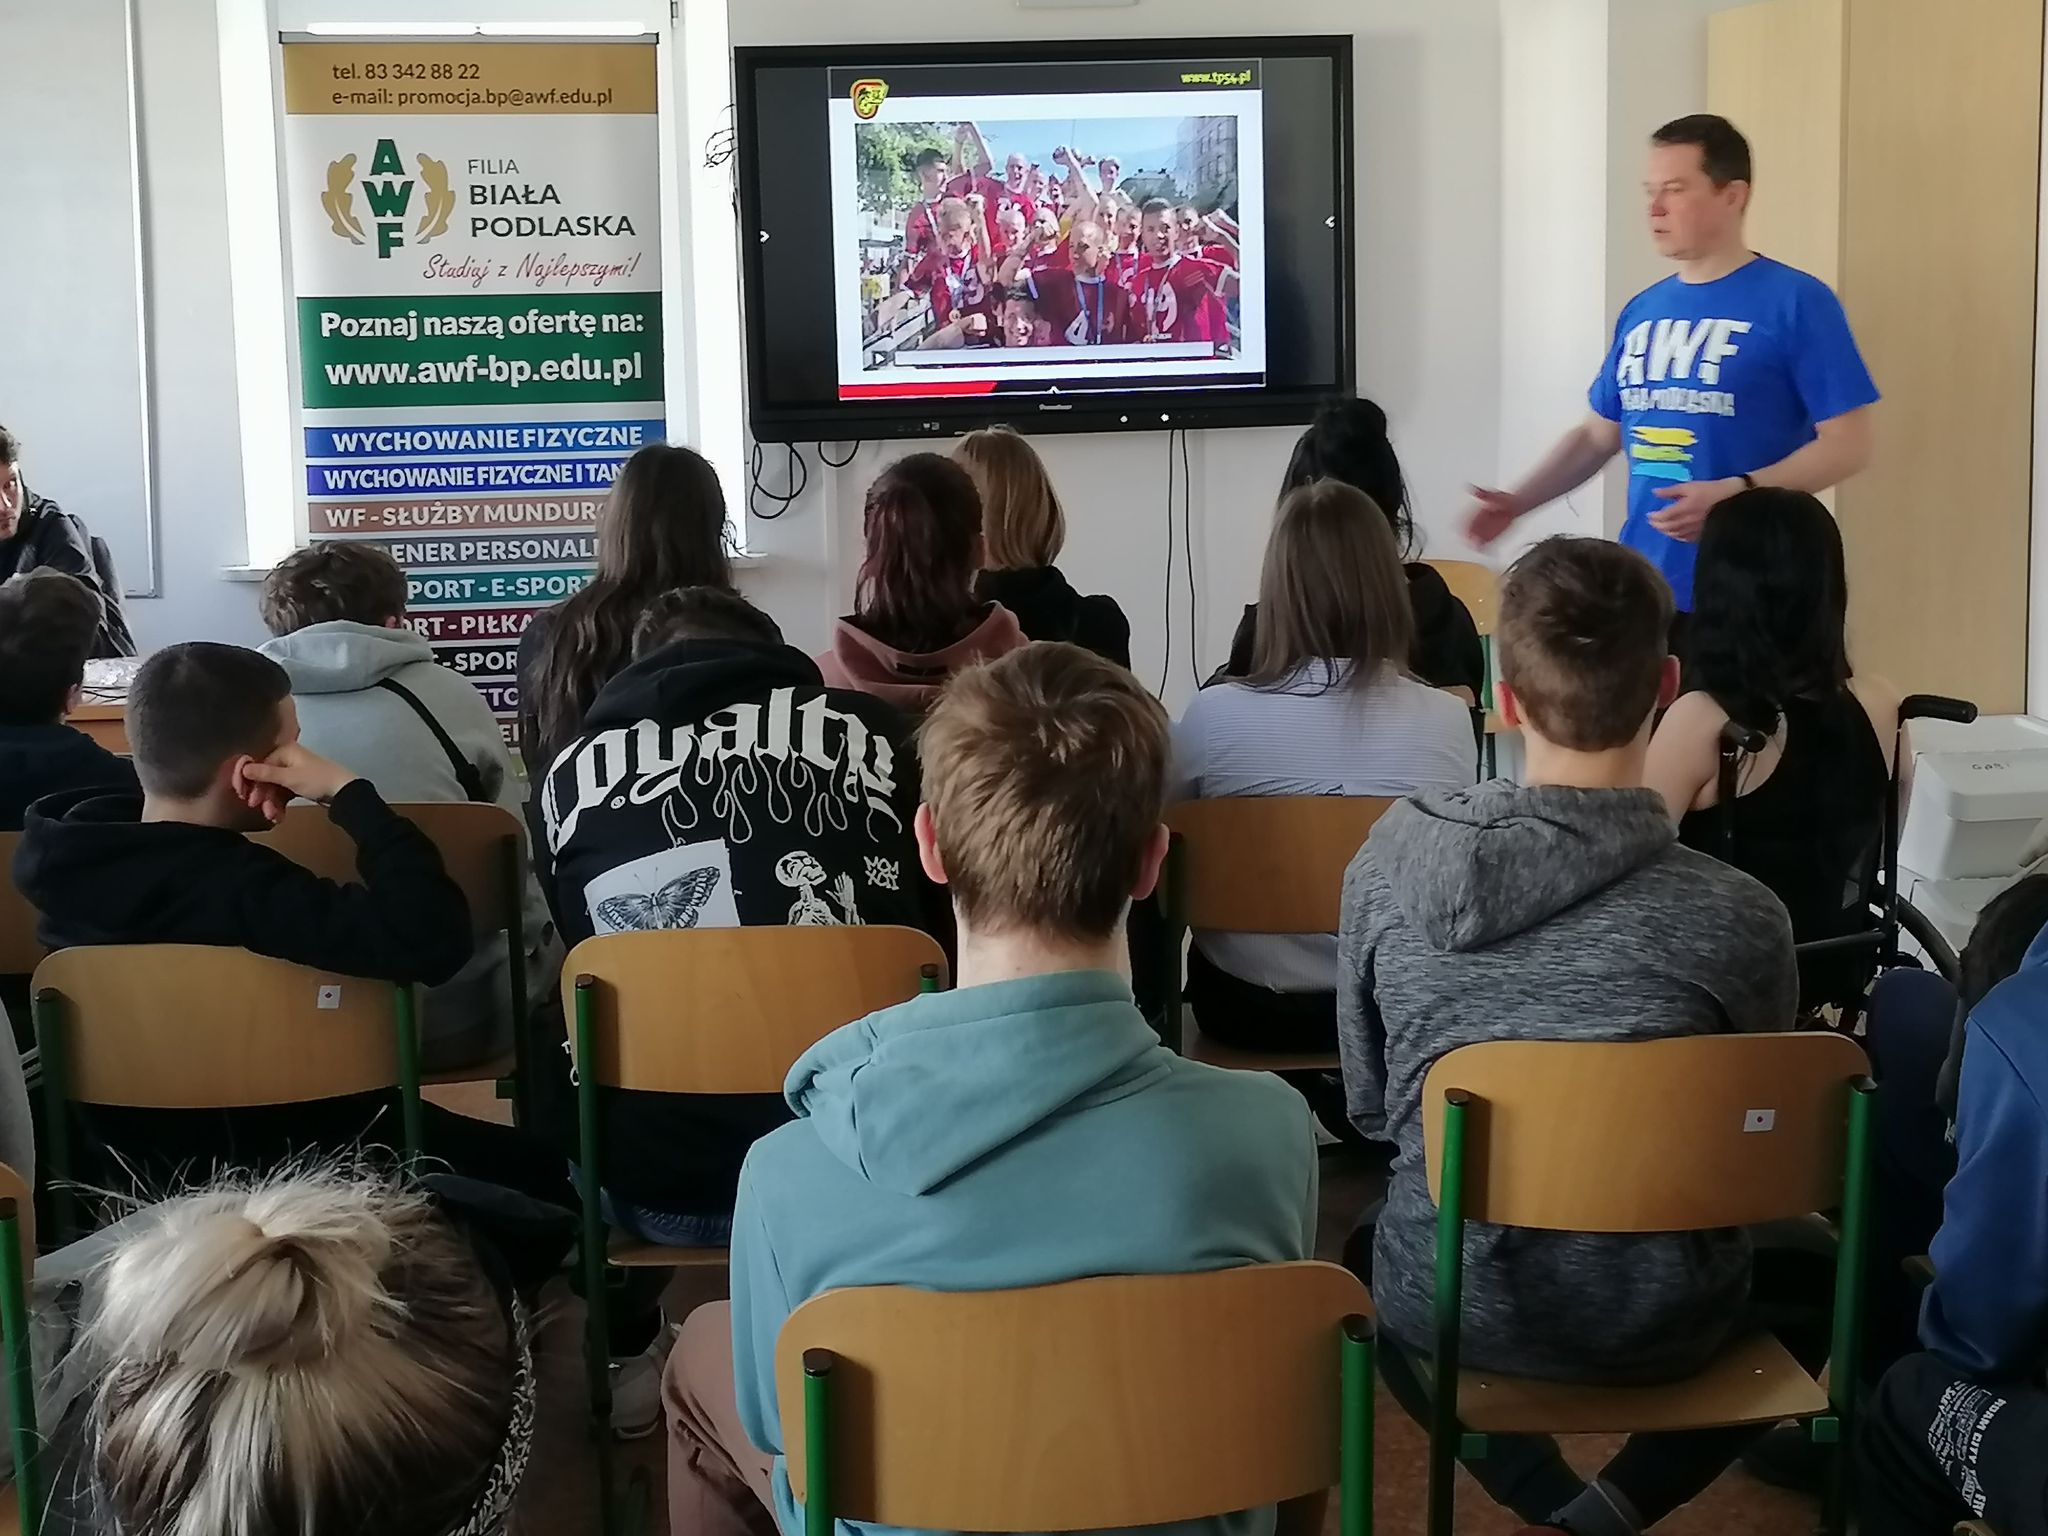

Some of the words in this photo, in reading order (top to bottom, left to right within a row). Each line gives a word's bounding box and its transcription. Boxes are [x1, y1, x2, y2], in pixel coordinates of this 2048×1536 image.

[332, 63, 361, 80] tel.
[365, 63, 388, 80] 83
[392, 63, 427, 80] 342
[430, 63, 453, 80] 88
[457, 62, 480, 80] 22
[332, 88, 394, 105] e-mail:
[398, 87, 613, 107] promocja.bp@awf.edu.pl
[468, 159, 520, 175] FILIA
[469, 184, 561, 206] BIAŁA
[470, 215, 636, 238] PODLASKA
[497, 265, 507, 278] z
[515, 252, 642, 287] Najlepszymi!
[320, 310, 418, 341] Poznaj
[423, 315, 505, 340] naszą
[508, 309, 597, 338] ofertę
[602, 312, 645, 333] na:
[1616, 318, 1753, 388] AWF
[325, 352, 643, 388] www.awf-bp.edu.pl
[332, 429, 522, 452] WYCHOWANIE
[523, 426, 643, 447] FIZYCZNE
[324, 465, 475, 490] WYCHOWANIE
[477, 464, 574, 486] FIZYCZNE
[576, 464, 583, 482] I
[325, 507, 367, 528] WF
[383, 501, 484, 526] SŁUŻBY
[391, 543, 457, 563] ENER
[407, 579, 475, 599] PORT
[454, 651, 518, 671] SPOR
[1967, 1431, 1984, 1465] CITY
